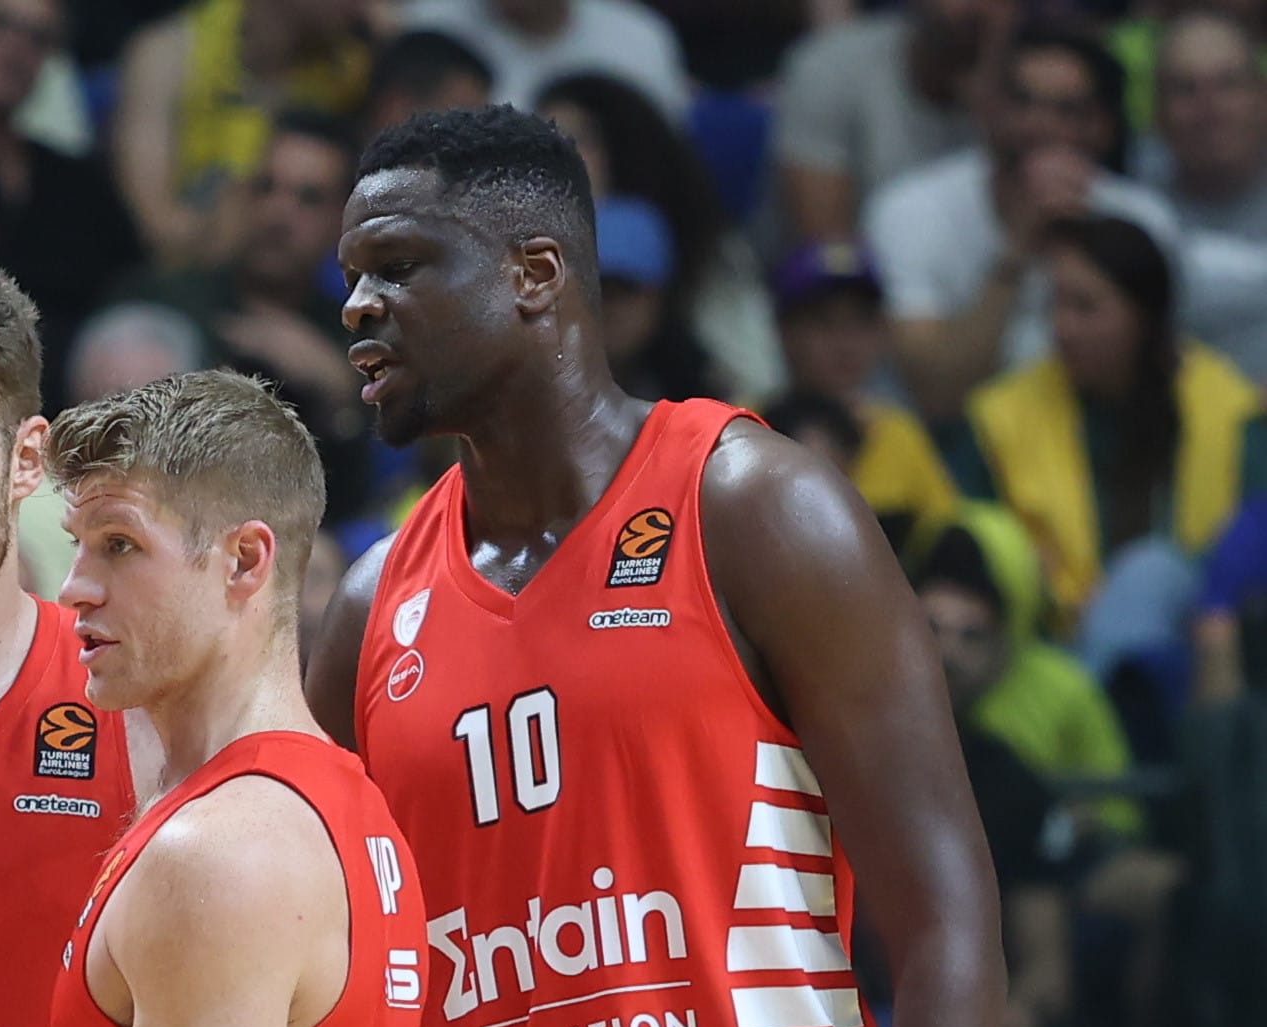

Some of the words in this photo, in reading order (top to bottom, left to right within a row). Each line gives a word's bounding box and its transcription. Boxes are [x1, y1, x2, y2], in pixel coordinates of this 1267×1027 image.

[616, 558, 661, 569] TURKISH
[613, 566, 659, 577] AIRLINES
[590, 608, 670, 628] oneteam
[40, 750, 90, 762] TURKISH
[452, 684, 561, 828] 10
[39, 759, 90, 771] AIRLINES
[38, 767, 90, 778] EuroLeague
[14, 795, 100, 817] oneteam
